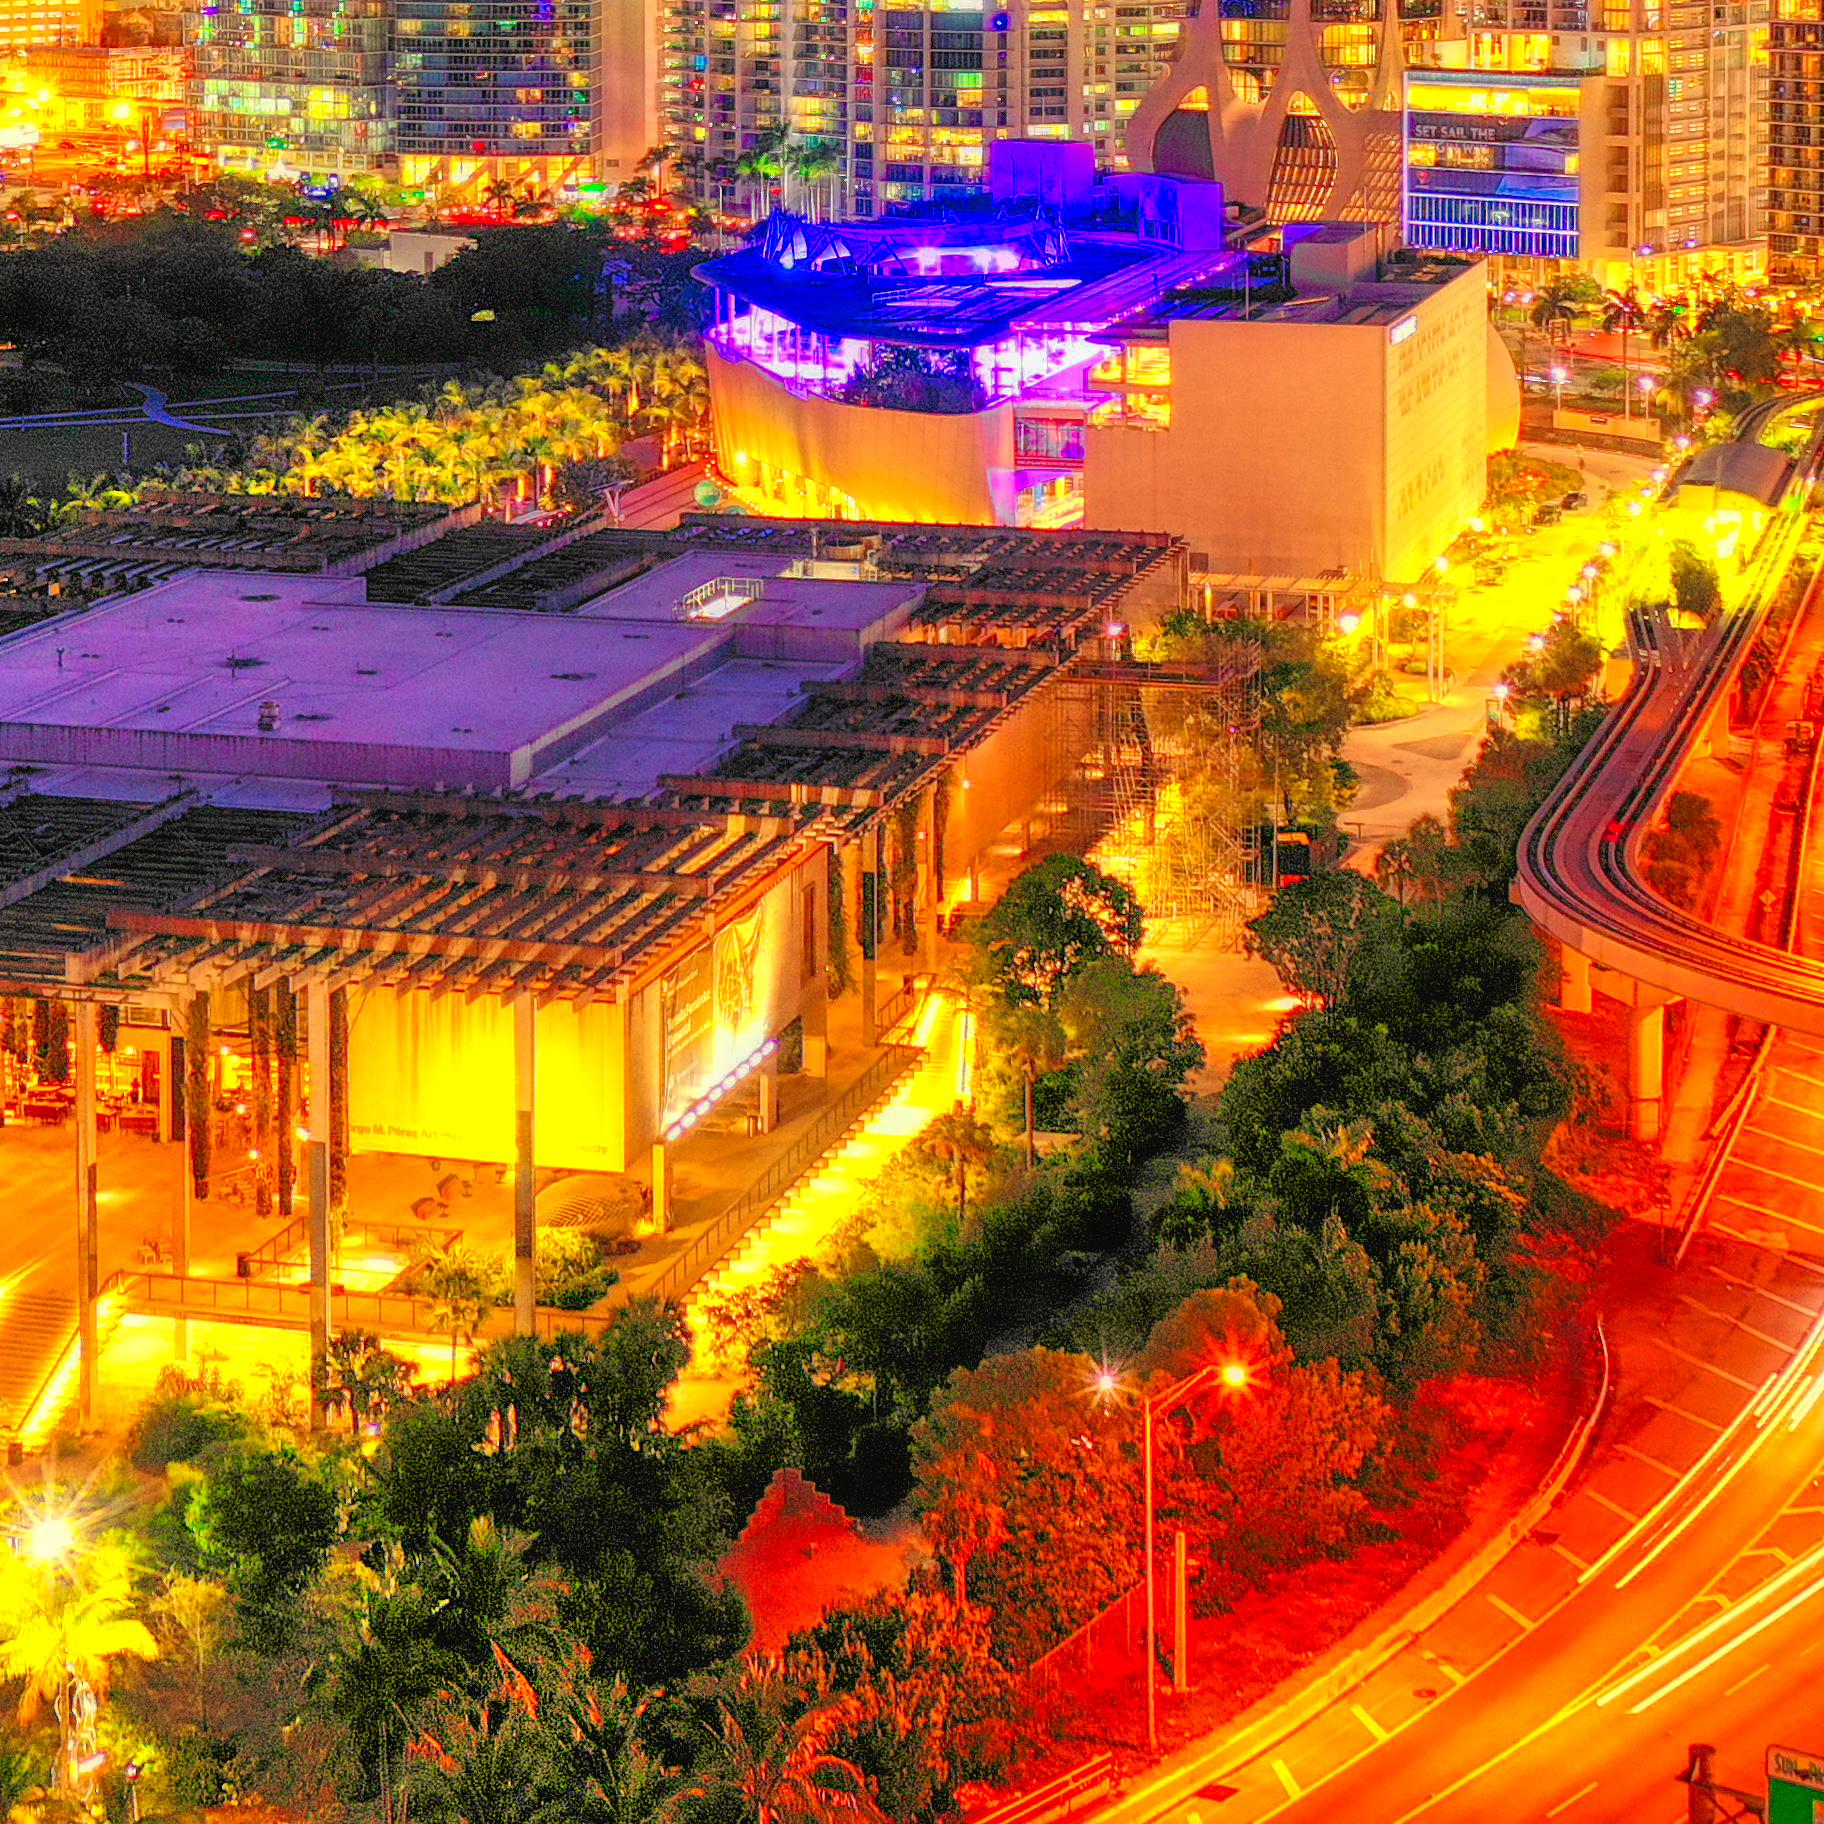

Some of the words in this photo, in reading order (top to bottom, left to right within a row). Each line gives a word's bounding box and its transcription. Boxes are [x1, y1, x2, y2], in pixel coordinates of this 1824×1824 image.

[1414, 125, 1438, 138] SET
[1440, 126, 1468, 139] SAIL
[1470, 128, 1496, 140] THE
